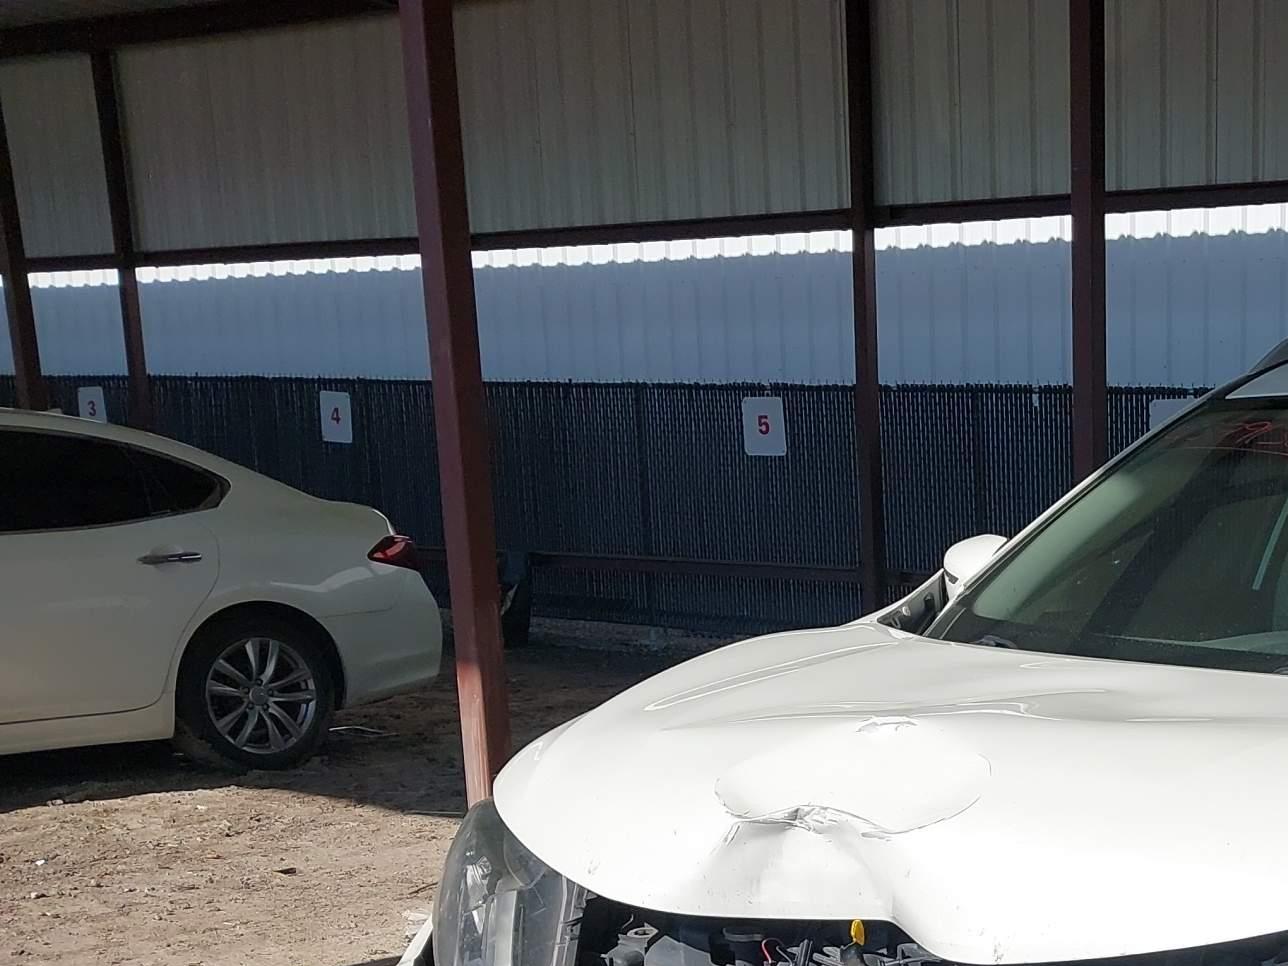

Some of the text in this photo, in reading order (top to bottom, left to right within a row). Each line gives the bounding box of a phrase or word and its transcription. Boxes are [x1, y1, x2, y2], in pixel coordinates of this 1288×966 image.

[87, 400, 97, 416] 3
[330, 407, 341, 424] 4
[757, 415, 770, 436] 5
